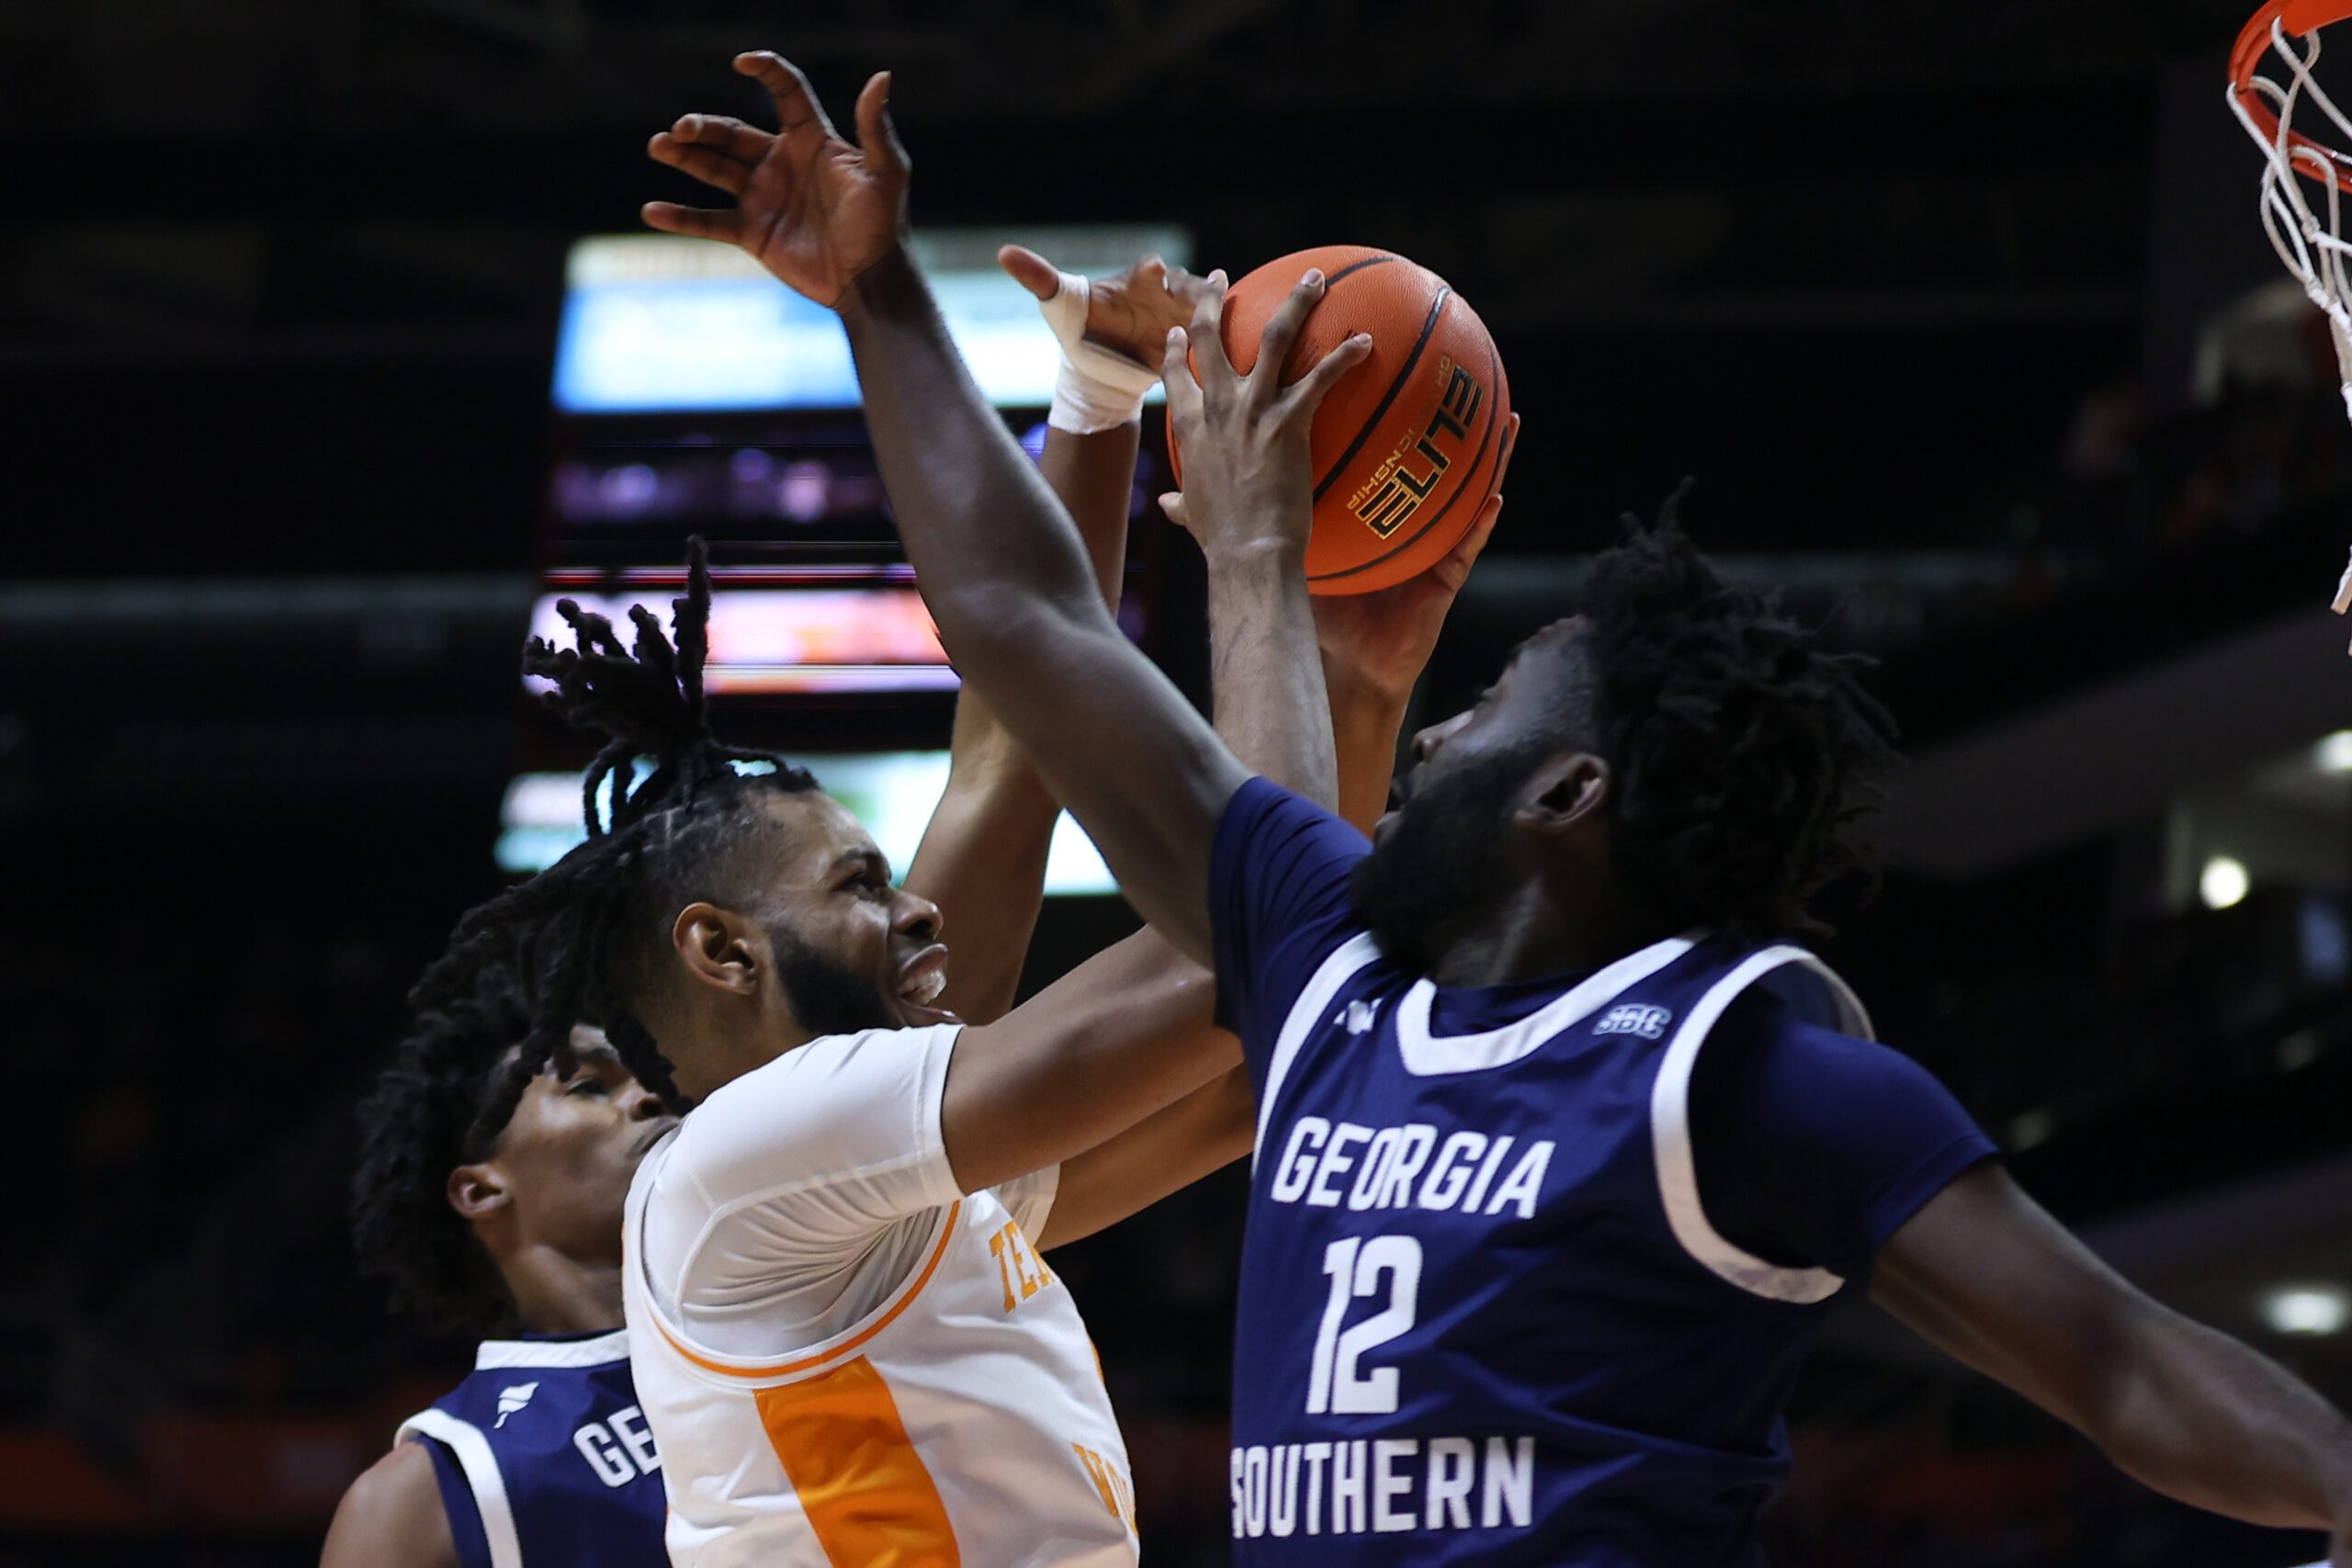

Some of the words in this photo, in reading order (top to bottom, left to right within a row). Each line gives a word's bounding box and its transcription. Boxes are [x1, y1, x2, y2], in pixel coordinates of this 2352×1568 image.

[1355, 365, 1484, 539] ELITE
[1271, 1116, 1556, 1220] GEORGIA
[1306, 1235, 1423, 1416] 12
[1231, 1437, 1536, 1540] SOUTHERN
